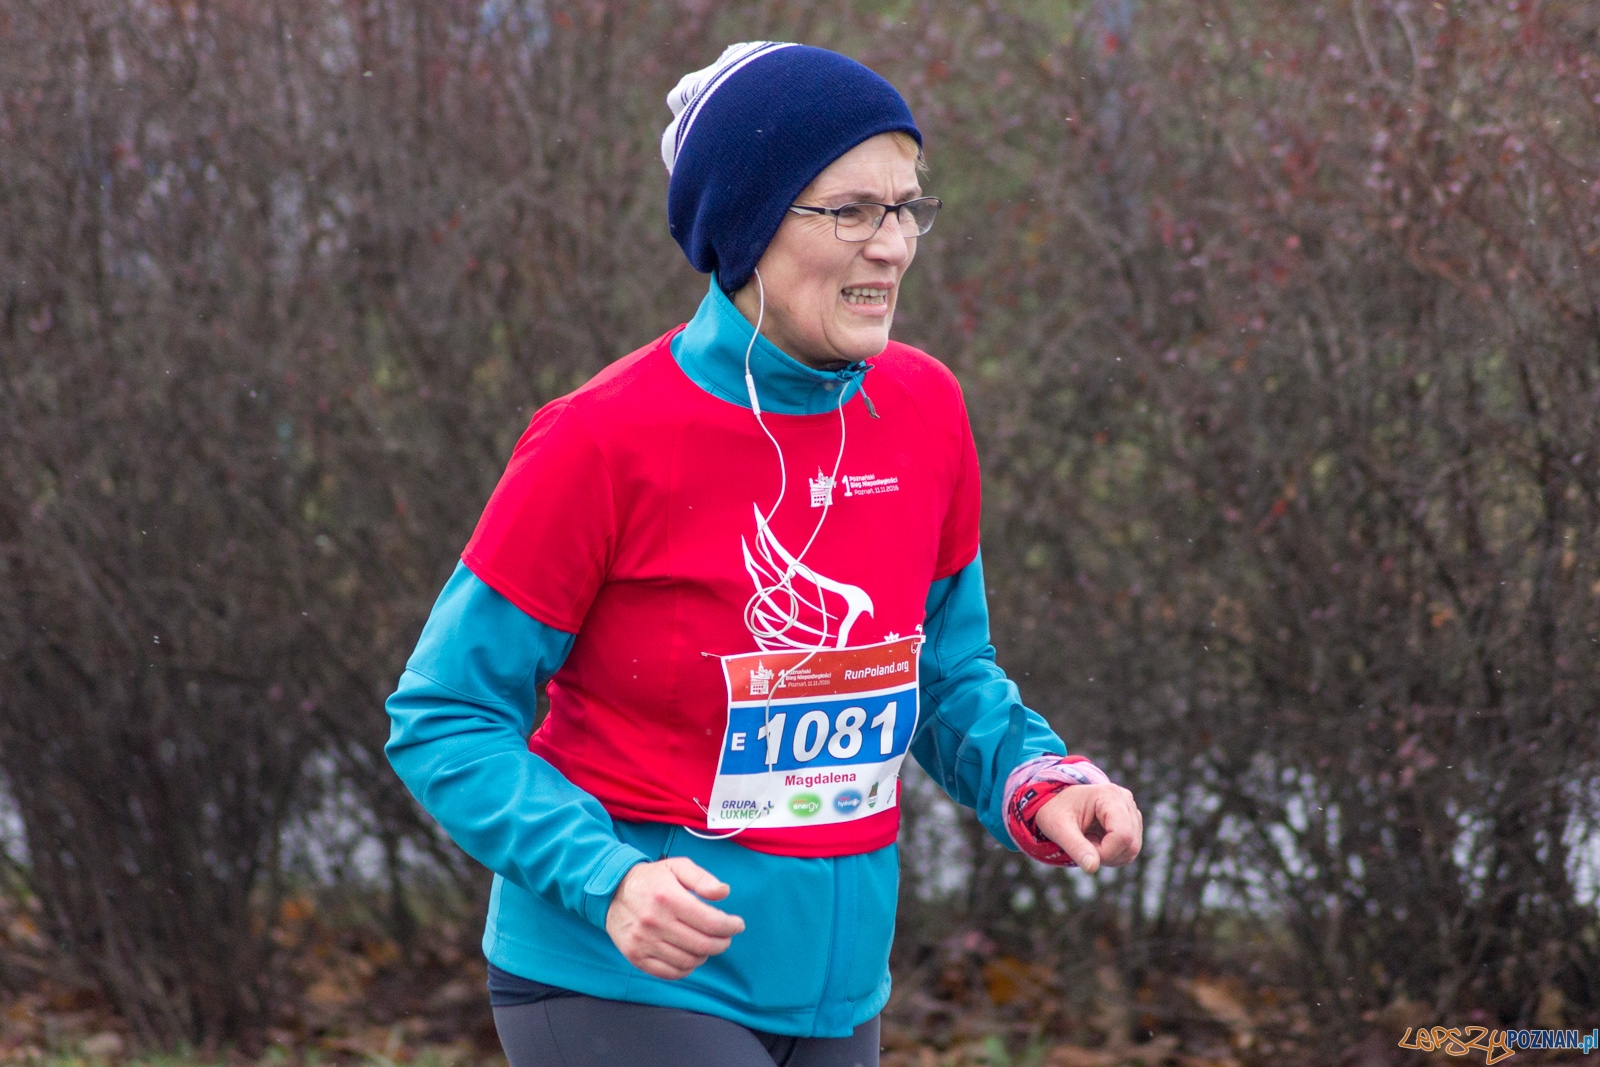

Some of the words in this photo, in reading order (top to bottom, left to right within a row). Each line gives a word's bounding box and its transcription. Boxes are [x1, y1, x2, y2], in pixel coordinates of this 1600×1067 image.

[842, 475, 853, 497] 1
[844, 660, 909, 680] RunPoland.org
[731, 732, 746, 751] E
[757, 701, 898, 766] 1081
[785, 772, 857, 788] Magdalena
[722, 800, 757, 810] GRUPA
[793, 801, 819, 812] energy
